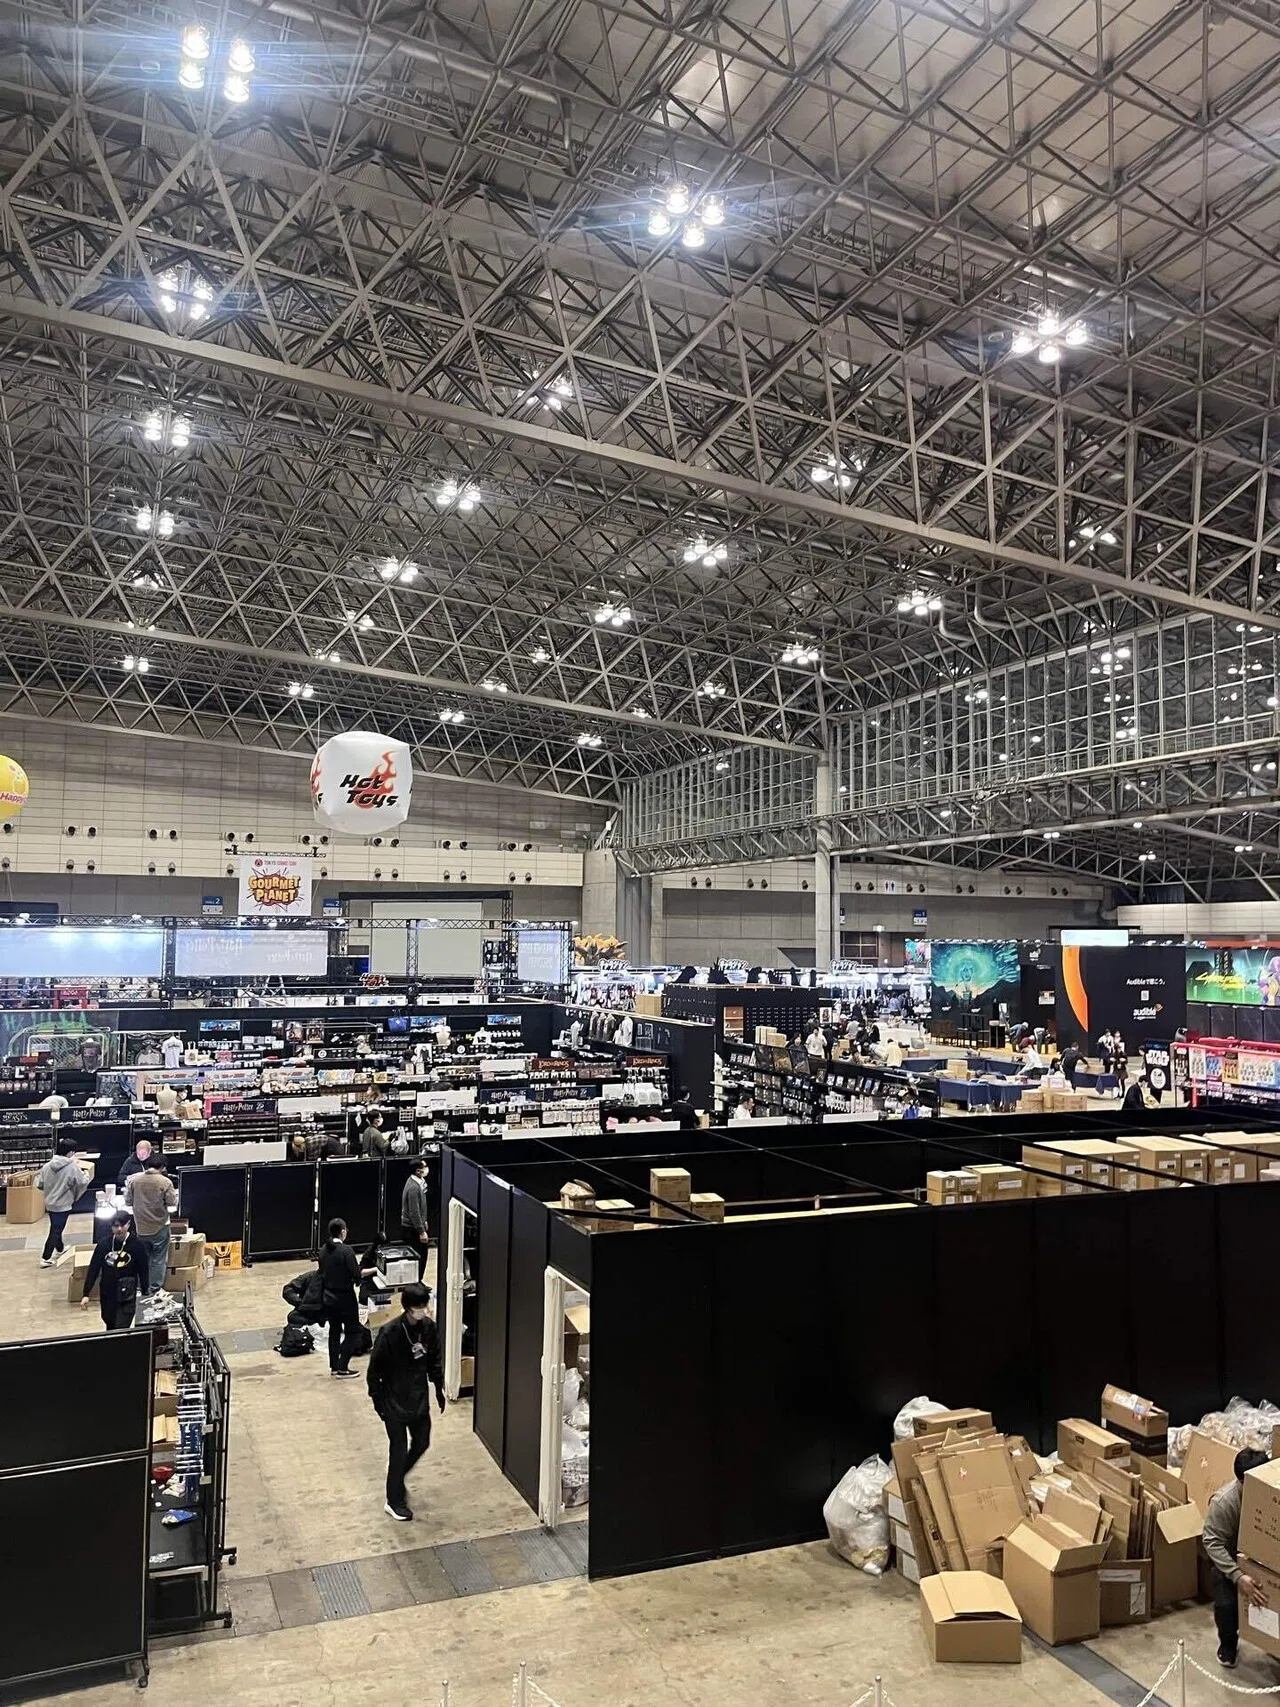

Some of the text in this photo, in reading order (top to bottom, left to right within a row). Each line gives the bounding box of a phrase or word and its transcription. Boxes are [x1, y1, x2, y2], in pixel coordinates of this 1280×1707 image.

[339, 774, 384, 789] Hot
[346, 790, 399, 808] Toys
[248, 875, 301, 889] GOURMET
[256, 889, 297, 902] PLANET
